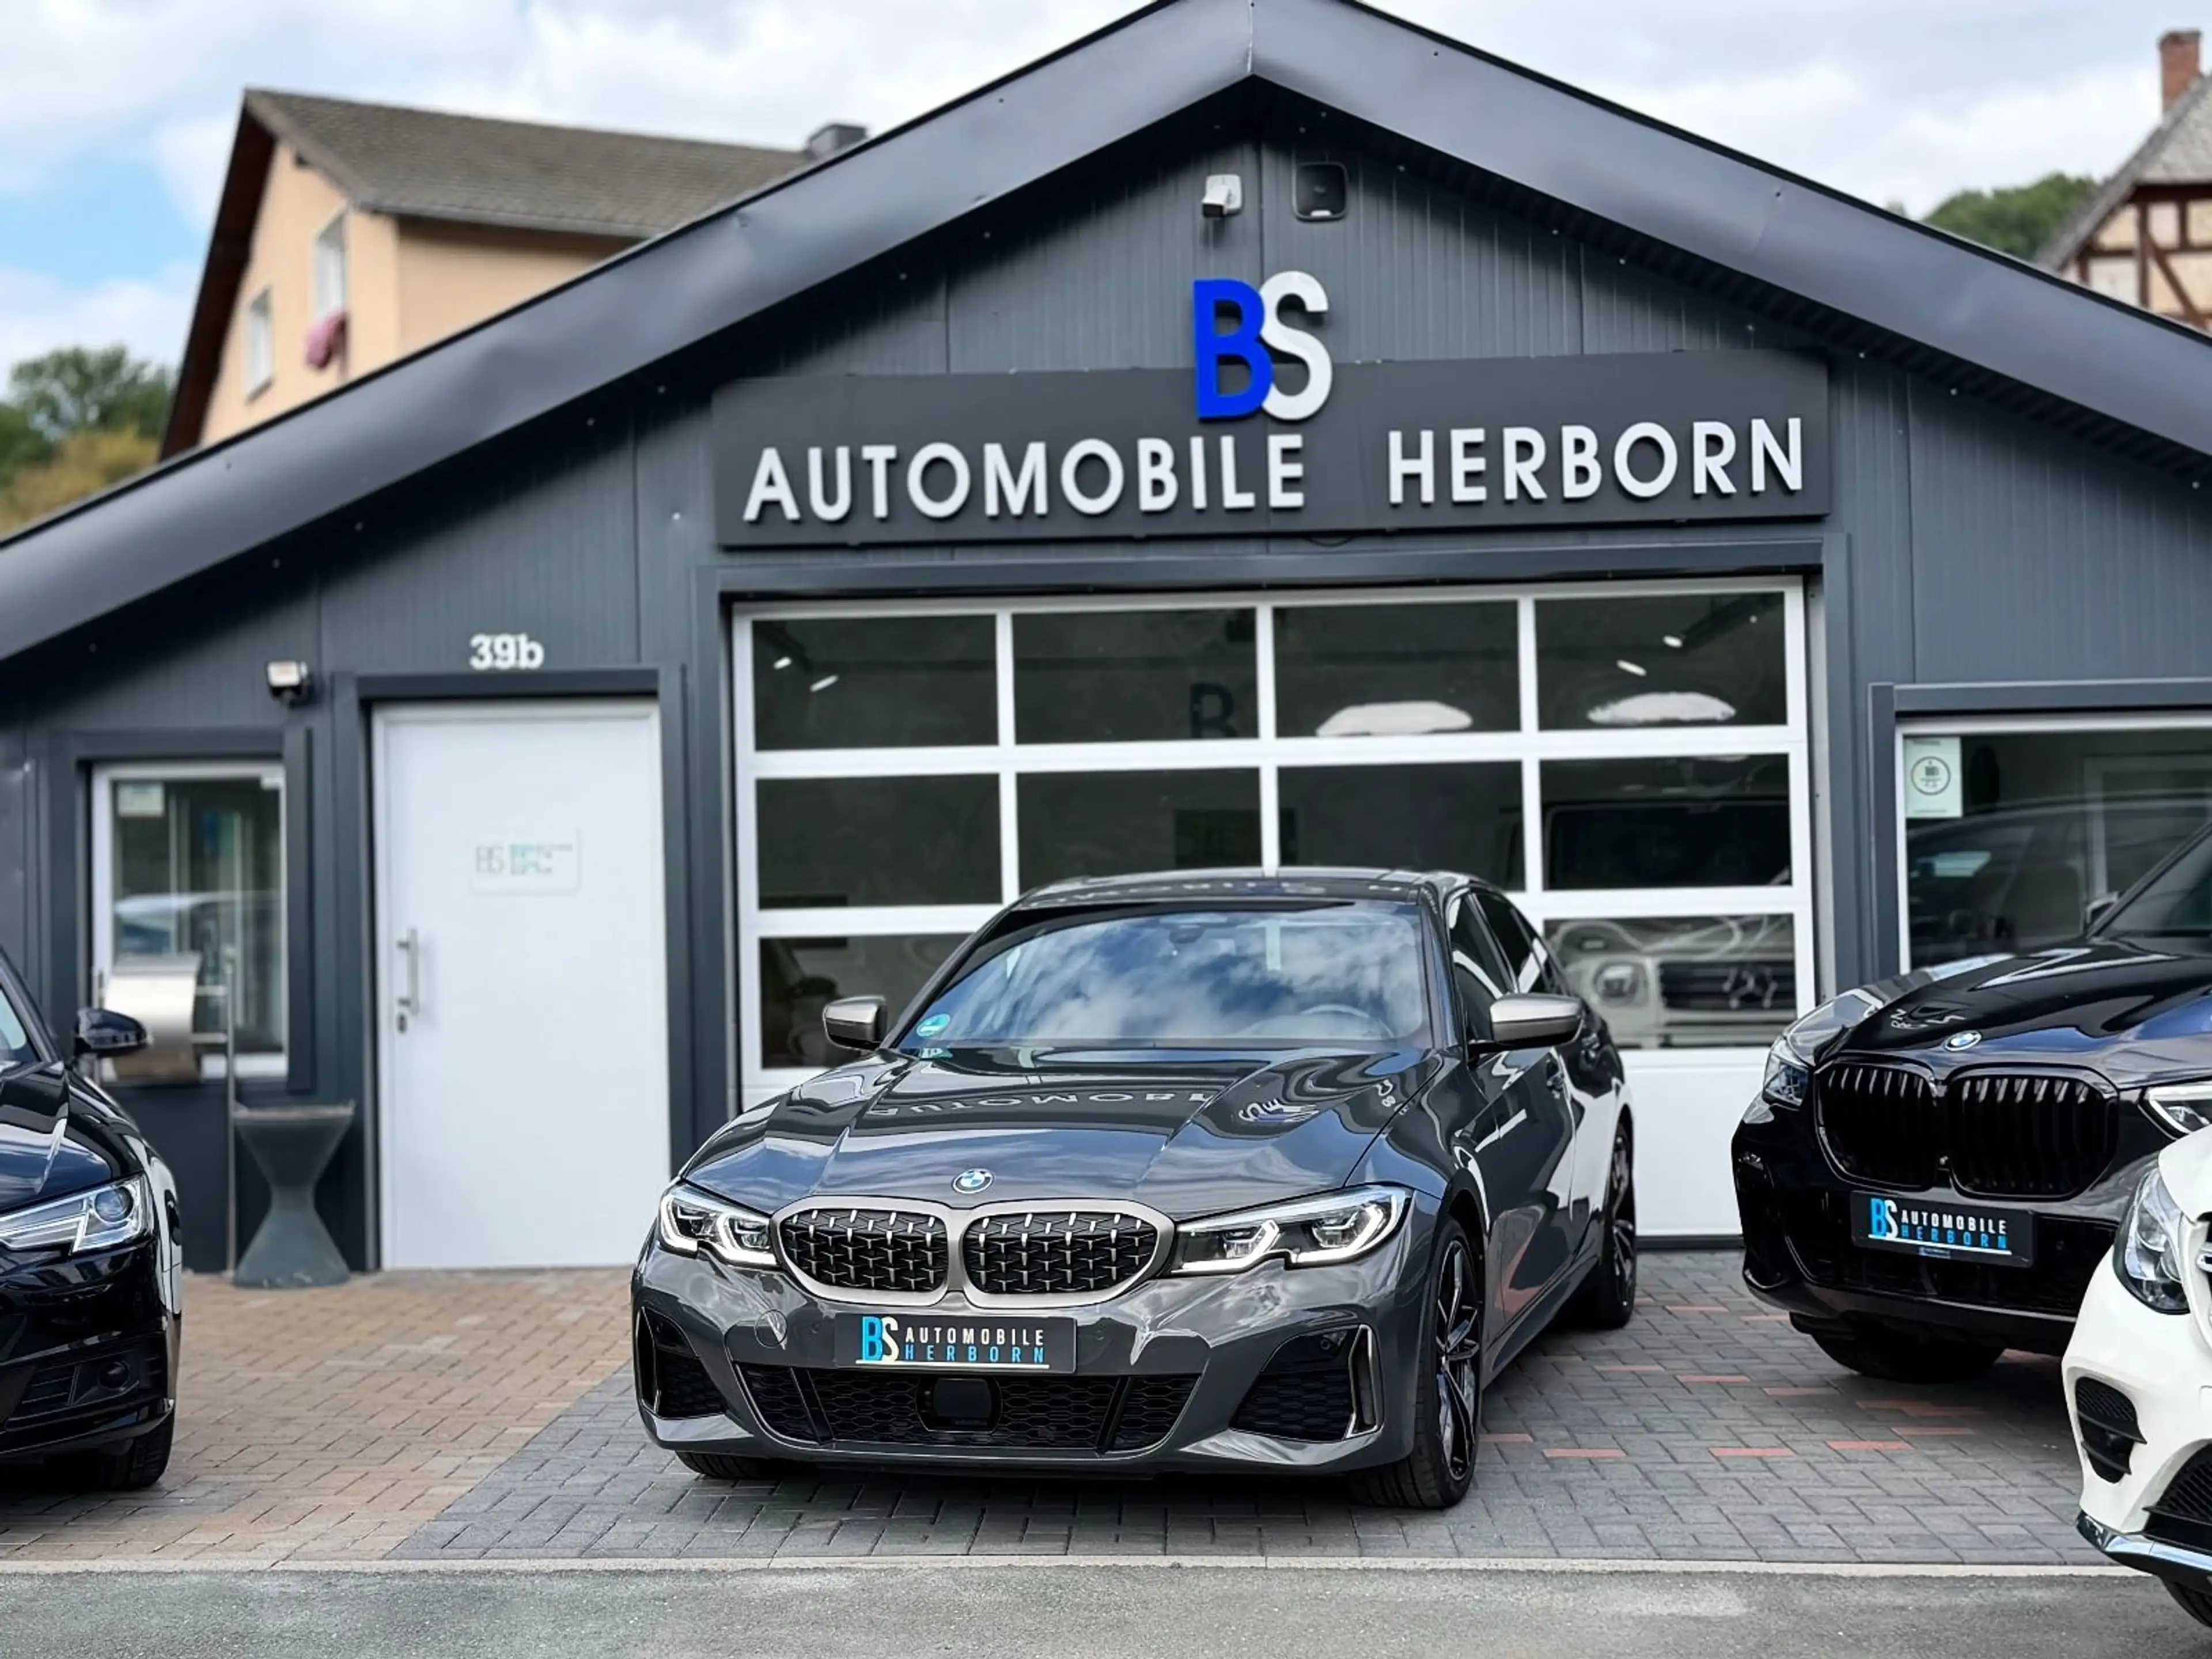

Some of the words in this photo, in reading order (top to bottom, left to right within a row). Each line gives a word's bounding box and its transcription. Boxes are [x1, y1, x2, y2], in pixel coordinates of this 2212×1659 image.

[1193, 270, 1332, 419] BS
[743, 433, 1305, 521] AUTOMOBILE
[1388, 416, 1802, 503] HERBORN
[469, 632, 545, 671] 39b
[1870, 1197, 1899, 1239] BS
[1901, 1209, 2008, 1234] AUTOMOBILE
[1901, 1222, 2008, 1250] HERBORN
[862, 1316, 900, 1362] BS
[904, 1344, 1045, 1363] HERBORN
[905, 1327, 1044, 1346] AUTOMOBILE
